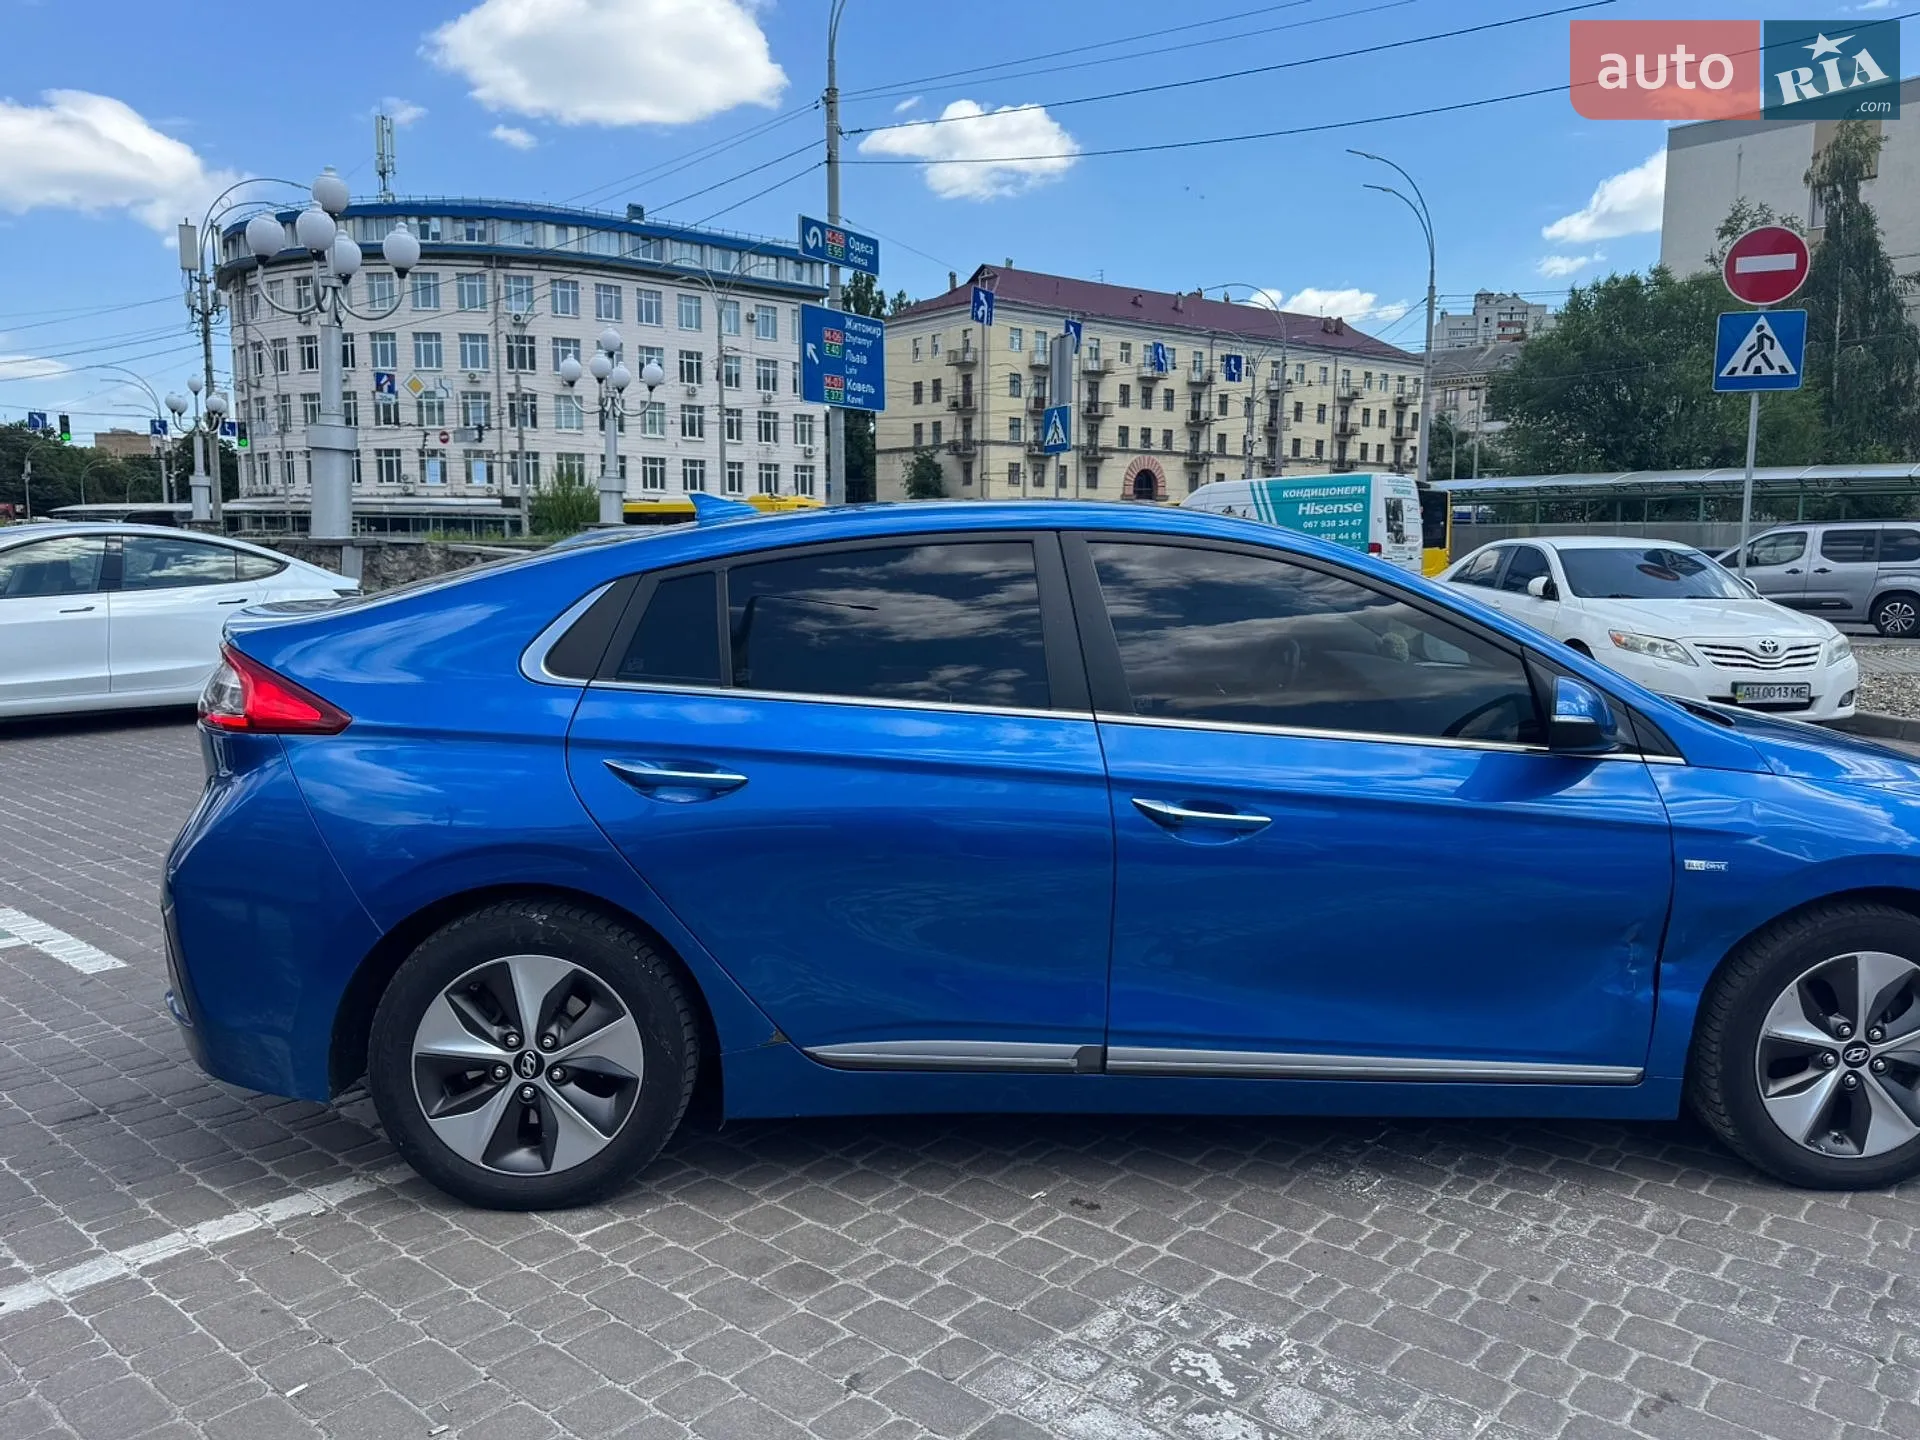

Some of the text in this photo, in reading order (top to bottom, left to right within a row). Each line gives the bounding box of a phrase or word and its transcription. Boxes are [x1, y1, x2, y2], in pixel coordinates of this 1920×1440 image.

[849, 236, 874, 256] Одеса
[849, 252, 868, 267] Odesa
[844, 316, 882, 338] Житомир
[845, 349, 868, 365] Львів
[845, 365, 858, 375] Lviv
[846, 378, 876, 394] Ковель
[846, 393, 864, 405] Kovel
[1282, 485, 1366, 499] КОНДИЦІОНЕРИ
[1298, 502, 1364, 515] Hisense
[1302, 520, 1319, 529] 067
[1338, 519, 1349, 527] 34
[1351, 518, 1362, 526] 47
[1351, 531, 1361, 539] 61
